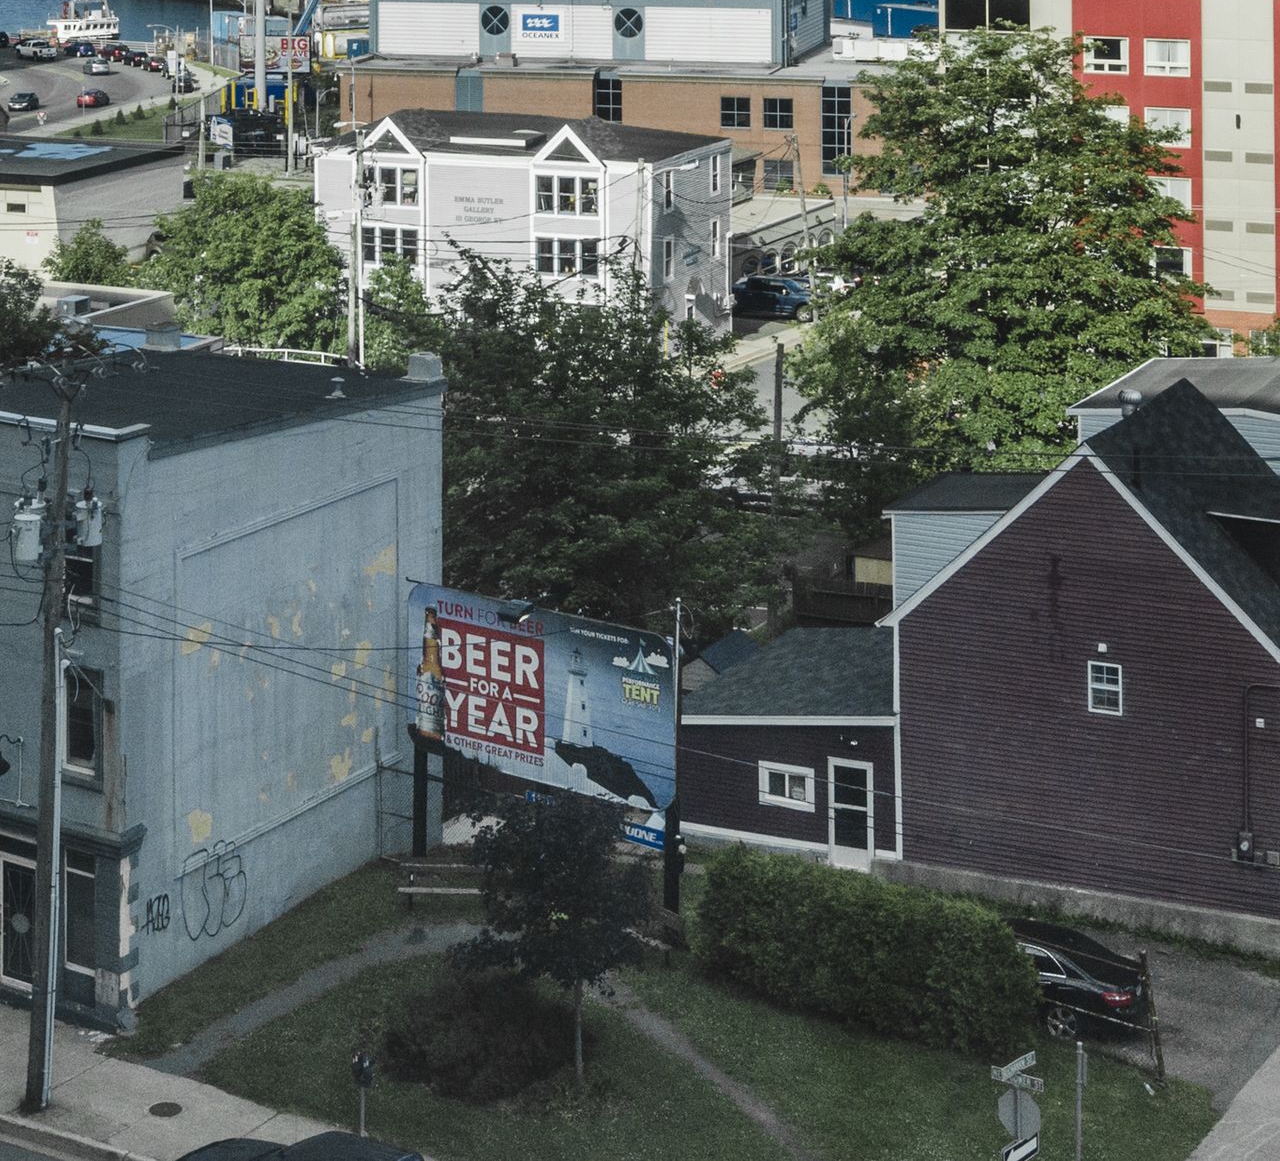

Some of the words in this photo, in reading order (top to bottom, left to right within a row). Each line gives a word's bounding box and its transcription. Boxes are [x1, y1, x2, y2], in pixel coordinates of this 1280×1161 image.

[281, 38, 308, 50] BIG
[437, 600, 473, 620] TURN
[581, 629, 596, 638] YOUR
[596, 632, 616, 642] TICKETS
[441, 628, 540, 689] BEER
[470, 678, 499, 698] FOR
[501, 686, 513, 701] A
[623, 684, 660, 705] TENT
[445, 689, 538, 748] YEAR
[446, 734, 452, 744] &
[454, 737, 483, 752] OTHER
[485, 745, 513, 760] GREAT
[515, 752, 544, 767] PRIZES
